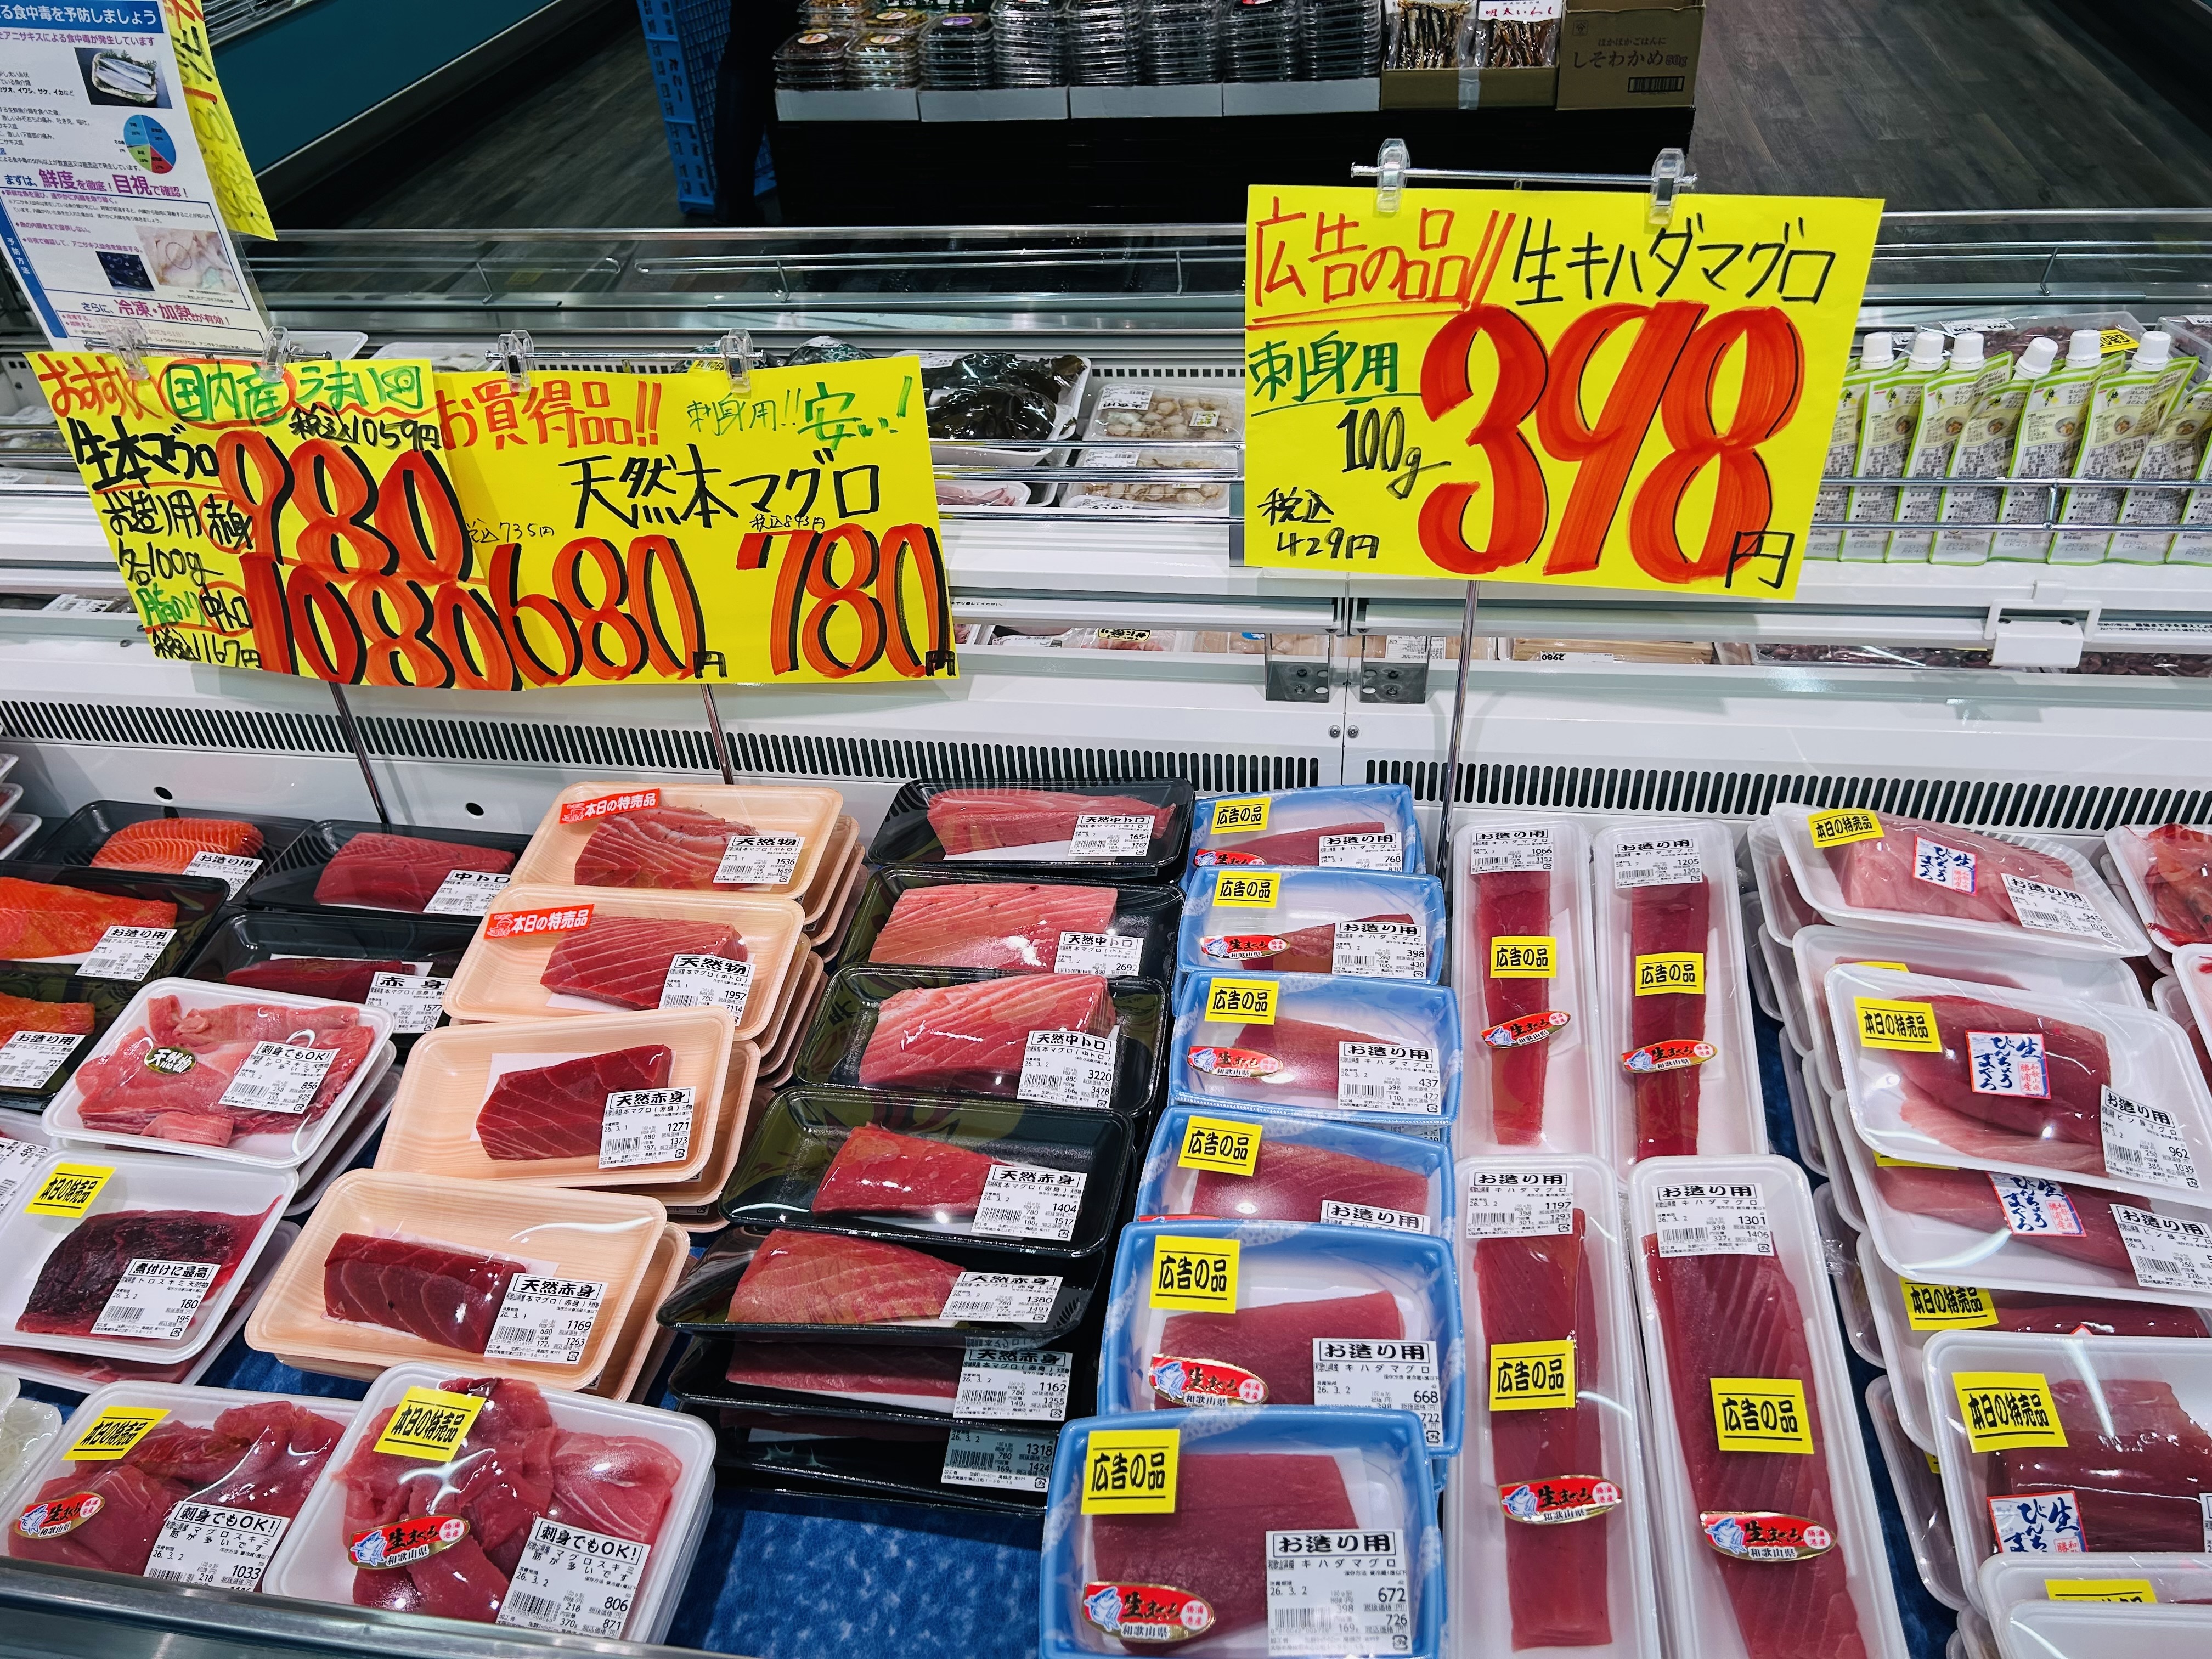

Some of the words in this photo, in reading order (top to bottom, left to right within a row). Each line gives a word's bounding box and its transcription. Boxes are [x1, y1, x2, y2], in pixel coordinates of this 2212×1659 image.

[1573, 50, 1663, 69] しそわかめ
[7, 237, 30, 275] 予防方法
[1511, 211, 1838, 307] 生キハダマグロ
[1248, 330, 1400, 403] 刺身用
[167, 363, 282, 426] 国内産
[1336, 404, 1452, 500] 100g
[557, 443, 880, 529] 天然本マグロ
[216, 430, 473, 582] 980
[584, 792, 657, 818] 本日の特売品
[1216, 805, 1262, 825] 広告の品
[1479, 830, 1545, 840] お造り用
[1815, 815, 1872, 839] 本日の特売品
[736, 838, 798, 846] 天然物
[1327, 834, 1393, 845] お造り用
[1621, 840, 1690, 851] お造り用
[199, 854, 255, 868] お造り用
[1953, 853, 1973, 869] 生
[454, 872, 510, 883] 中トロ
[1220, 881, 1271, 900] 広告の品
[2011, 878, 2083, 901] お造り用
[512, 908, 590, 935] 本日の特売品
[1342, 923, 1418, 935] お造り用
[110, 928, 168, 940] お造り用
[1068, 934, 1133, 947] 天然中トロ
[1406, 950, 1425, 958] 398
[1496, 947, 1549, 968] 広告の品
[678, 957, 747, 975] 天然物
[1115, 963, 1138, 972] 2692
[379, 976, 445, 989] 赤身
[1641, 964, 1696, 986] 広告の品
[725, 990, 747, 1000] 1957
[1212, 988, 1269, 1012] 広告の品
[422, 1003, 442, 1012] 1577
[1509, 1018, 1549, 1036] 生まぐろ
[1863, 1007, 1930, 1039] 本日の特売品
[16, 1034, 76, 1045] お造り用
[1036, 1032, 1106, 1051] 天然中トロ
[261, 1044, 331, 1063] 刺身でもOK!
[1348, 1045, 1429, 1060] お造り用
[1652, 1045, 1694, 1062] 生まぐろ
[2015, 1037, 2041, 1059] 生
[1991, 1035, 2014, 1088] びんちょう
[1087, 1069, 1111, 1082] 3220
[1974, 1052, 1997, 1091] まぐろ
[2019, 1063, 2033, 1092] 勝浦産
[2030, 1063, 2042, 1093] 和歌山県
[301, 1081, 318, 1090] 856
[1091, 1086, 1110, 1095] 3478
[1418, 1078, 1438, 1088] 437
[616, 1091, 685, 1107] 天然赤身
[2107, 1092, 2171, 1125] お造り用
[667, 1121, 689, 1132] 1271
[670, 1137, 687, 1145] 1373
[1187, 1129, 1250, 1161] 広告の品
[2169, 1146, 2190, 1159] 962
[2174, 1163, 2194, 1173] 1039
[1000, 1170, 1075, 1185] 天然赤身
[1477, 1173, 1563, 1184] お造り用
[38, 1177, 98, 1204] 本日の特売品
[1662, 1185, 1752, 1198] お造り用
[2036, 1177, 2066, 1197] 生
[1052, 1203, 1076, 1214] 1404
[1544, 1201, 1571, 1210] 1197
[2002, 1192, 2035, 1232] まぐろ
[1054, 1217, 1074, 1226] 1517
[1331, 1205, 1419, 1229] お造り用
[1737, 1216, 1766, 1225] 1301
[2122, 1209, 2204, 1235] お造り用
[132, 1262, 210, 1279] 煮付けに最高
[1158, 1254, 1228, 1293] 広告の品
[970, 1274, 1049, 1284] 天然赤身
[520, 1278, 595, 1297] 天然赤身
[180, 1299, 199, 1309] 180
[176, 1315, 190, 1323] 195
[567, 1319, 591, 1331] 1169
[566, 1337, 585, 1346] 1263
[977, 1349, 1060, 1364] 天然赤身
[1324, 1343, 1425, 1361] お造り用
[1345, 1364, 1430, 1373] キハダマグロ
[1497, 1358, 1565, 1393] 広告の品
[1039, 1383, 1066, 1392] 1162
[1043, 1397, 1065, 1405] 1255
[1413, 1390, 1438, 1404] 668
[1722, 1396, 1799, 1434] 広告の品
[1968, 1392, 2050, 1430] 本日の特売品
[390, 1406, 465, 1443] 本日の特売品
[78, 1419, 147, 1447] 本日の特売品
[1026, 1443, 1053, 1457] 1318
[1029, 1462, 1050, 1472] 1424
[1091, 1452, 1166, 1492] 広告の品
[1536, 1485, 1592, 1508] 生まぐろ
[179, 1506, 276, 1533] 刺身でもOK!
[1543, 1508, 1585, 1521] 和歌山県
[2048, 1496, 2079, 1533] 生
[384, 1523, 441, 1552] 生まぐろ
[1745, 1519, 1802, 1546] 生まぐろ
[540, 1525, 637, 1561] 刺身でもOK!
[1278, 1533, 1391, 1553] お造り用
[386, 1545, 429, 1566] 和歌山県
[1750, 1547, 1797, 1559] 和歌山県
[1301, 1558, 1396, 1568] キハダマグロ
[198, 1573, 214, 1582] 218
[232, 1565, 261, 1580] 1033
[1378, 1587, 1406, 1603] 672
[565, 1601, 581, 1612] 218
[603, 1596, 628, 1612] 806
[1124, 1589, 1181, 1621] 生まぐろ
[602, 1618, 622, 1630] 871
[1385, 1613, 1408, 1626] 726
[1121, 1624, 1171, 1639] 和歌山県
